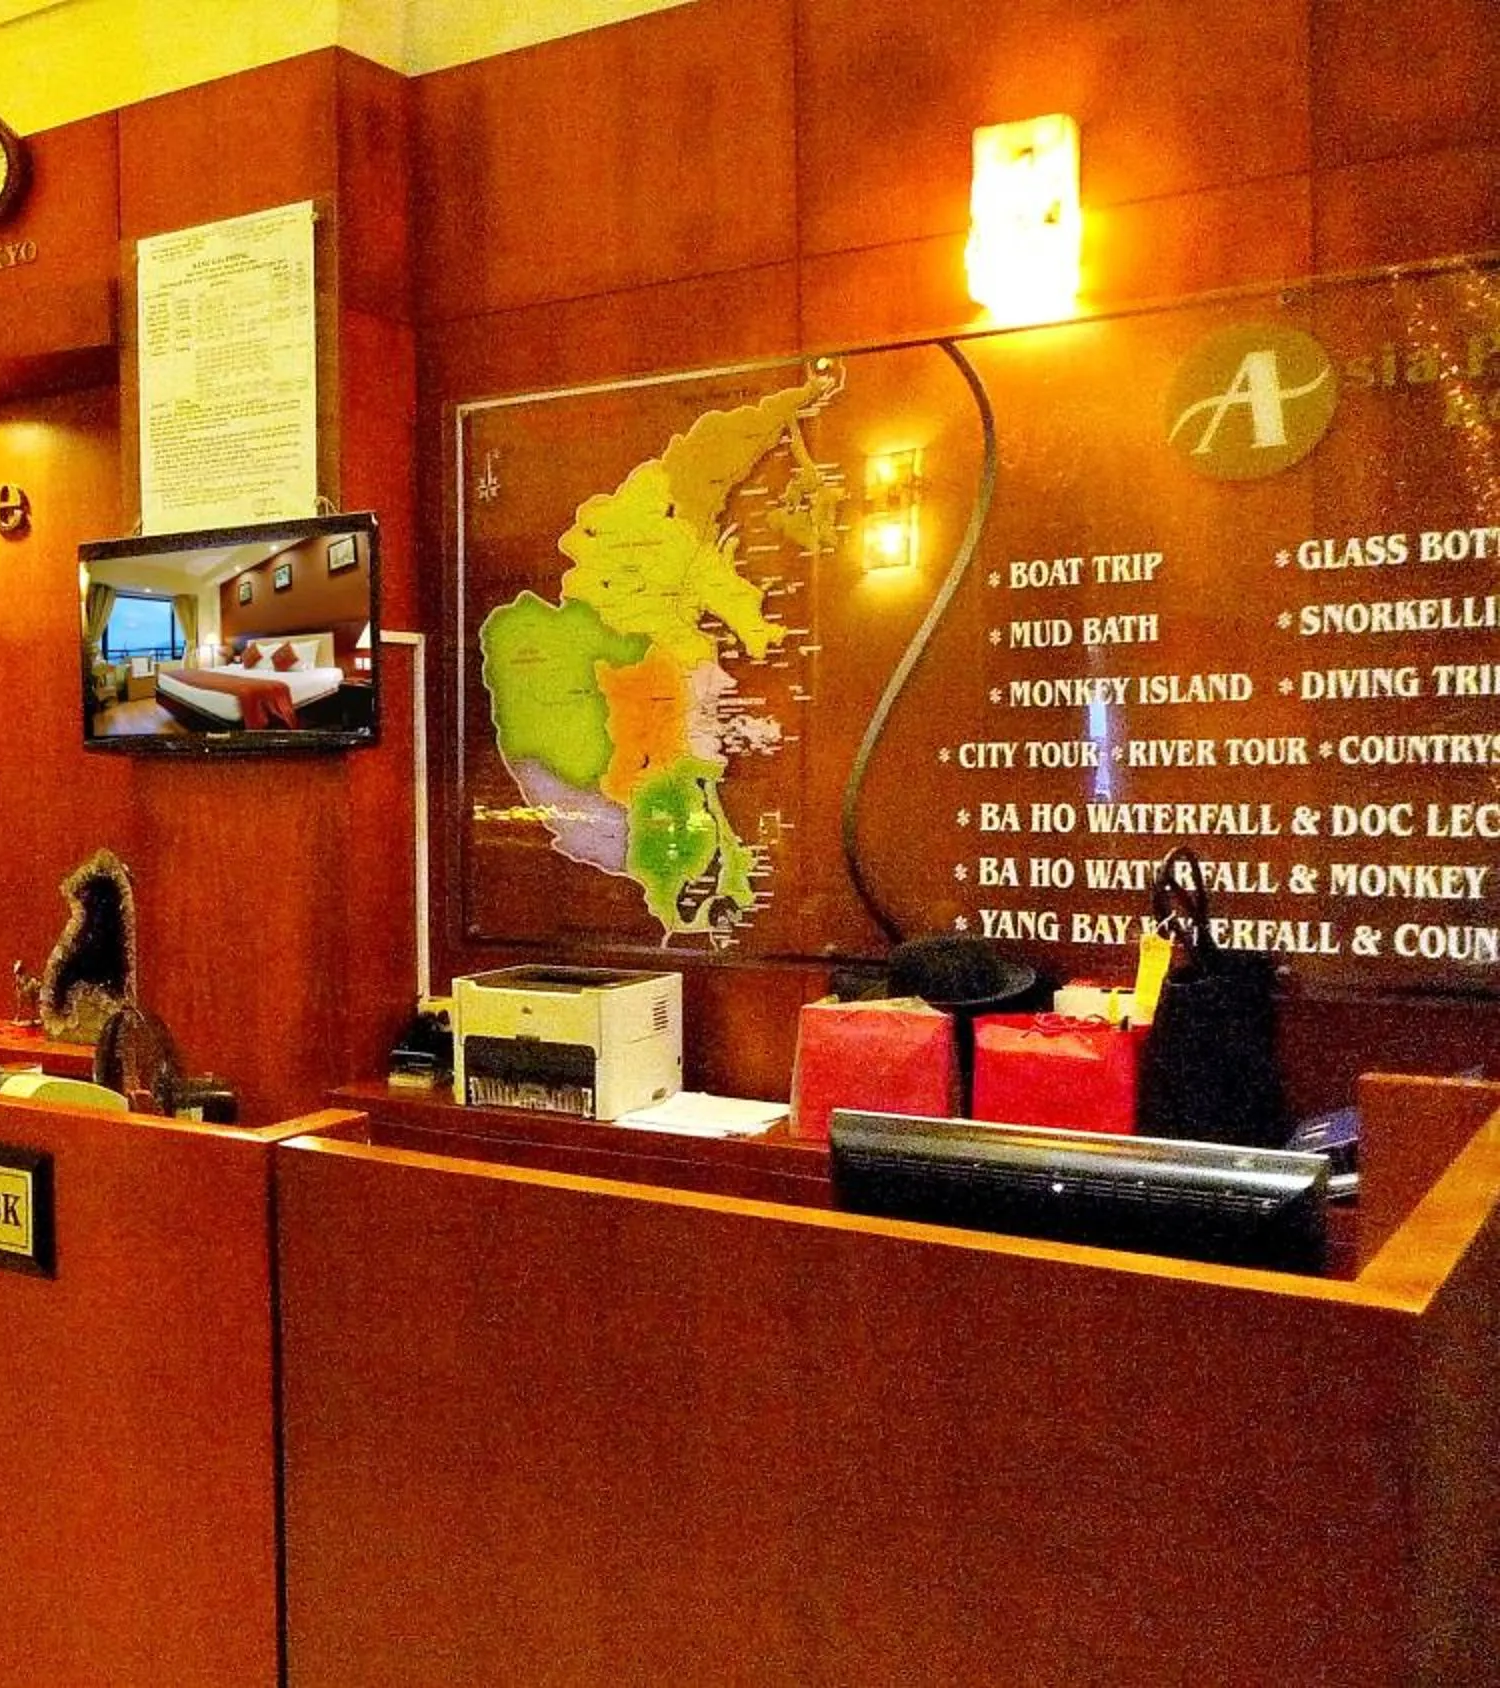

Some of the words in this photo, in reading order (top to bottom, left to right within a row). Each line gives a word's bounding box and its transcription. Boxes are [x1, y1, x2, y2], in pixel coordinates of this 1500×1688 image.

[1298, 533, 1409, 570] GLASS
[1009, 559, 1084, 589] BOAT
[1092, 553, 1163, 584] TRIP
[1009, 618, 1073, 648] MUD
[1081, 613, 1159, 646] BATH
[1299, 595, 1500, 636] SNORKELLI
[1009, 677, 1132, 707] MONKEY
[1139, 673, 1253, 704] ISLAND
[1301, 667, 1420, 699] DIVING
[1431, 663, 1500, 696] TRI
[958, 742, 1017, 768] CITY
[1024, 741, 1099, 768] TOUR
[1127, 739, 1216, 766] RIVER
[1224, 737, 1310, 765] TOUR
[980, 804, 1021, 834] BA
[1030, 804, 1076, 834] HO
[1086, 803, 1281, 836] WATERFALL
[1291, 804, 1321, 836] &
[1331, 803, 1414, 838] DOC
[979, 857, 1018, 887] BA
[1029, 858, 1075, 889] HO
[1288, 863, 1318, 895] &
[1331, 864, 1488, 899] MONKEY
[978, 909, 1060, 942] YANG
[1071, 913, 1133, 945] BAY
[1352, 925, 1382, 957] &
